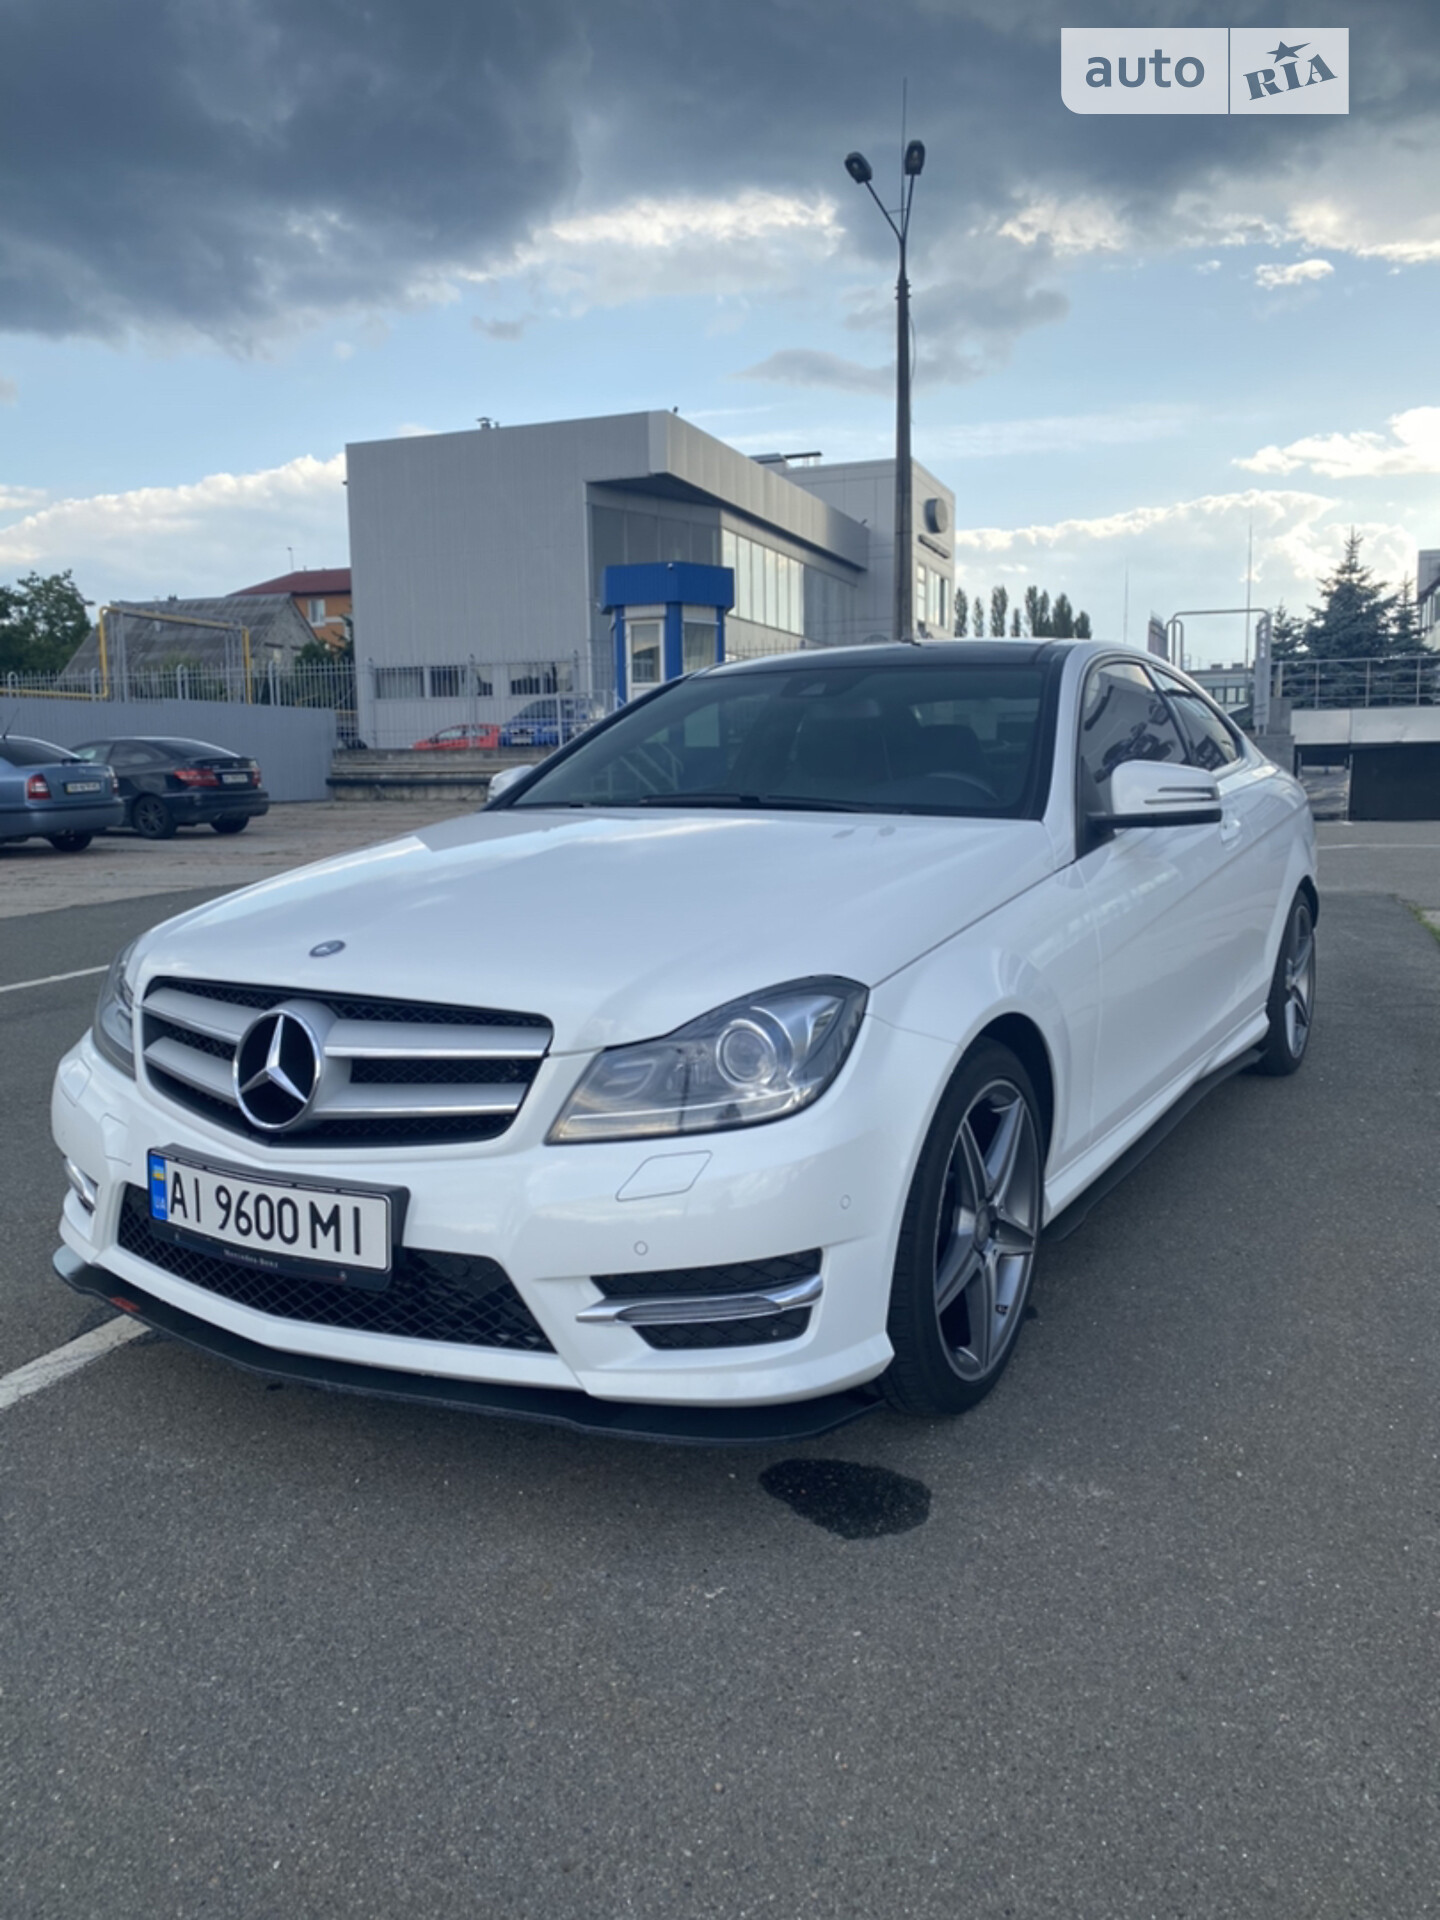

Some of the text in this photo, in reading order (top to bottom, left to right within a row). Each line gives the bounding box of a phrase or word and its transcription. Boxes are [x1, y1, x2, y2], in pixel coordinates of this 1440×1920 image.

[170, 1171, 361, 1256] AI 9600 MI
